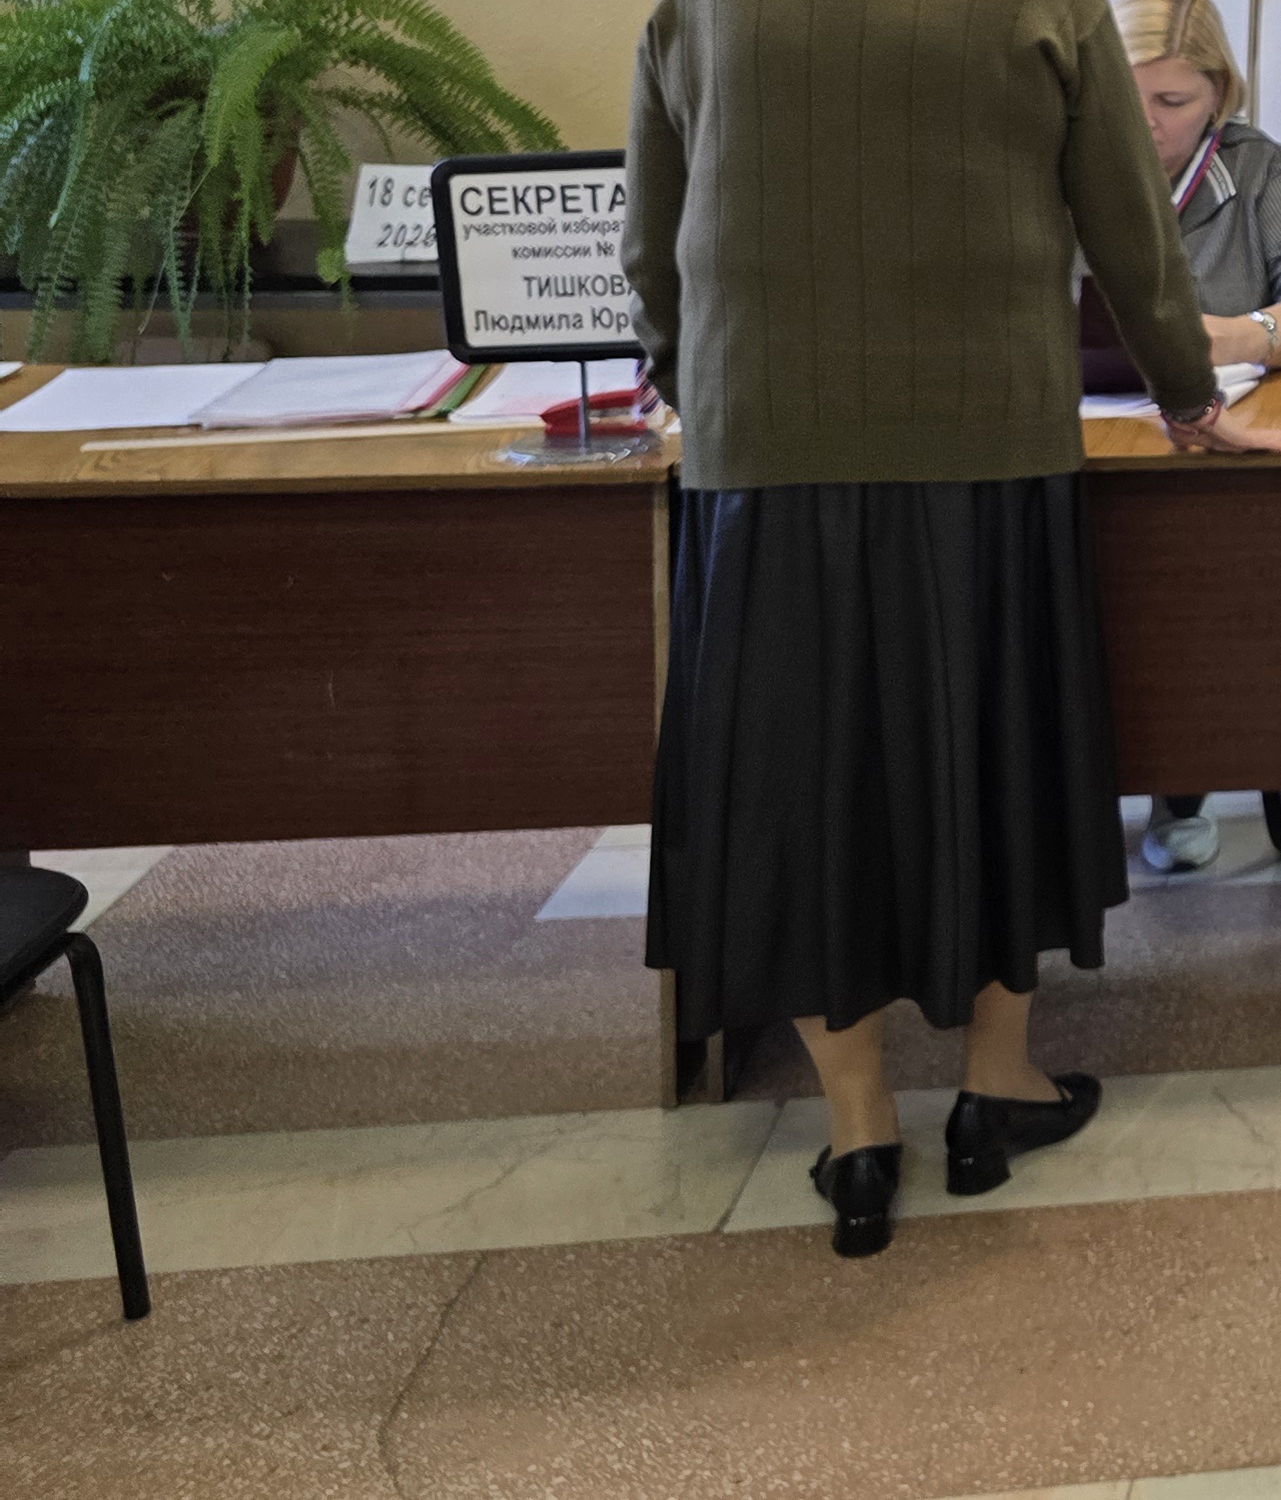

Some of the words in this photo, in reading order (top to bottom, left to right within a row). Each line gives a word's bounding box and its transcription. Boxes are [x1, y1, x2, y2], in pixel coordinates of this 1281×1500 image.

[369, 176, 395, 208] 18
[403, 185, 433, 208] се
[460, 183, 626, 217] СЕКРЕТА
[377, 223, 437, 248] 2026
[463, 218, 558, 241] участковой
[512, 245, 592, 259] комиссии
[595, 241, 616, 258] №
[523, 274, 635, 298] ТИШКОВ
[475, 309, 584, 335] Людмила
[591, 306, 631, 334] Юр
